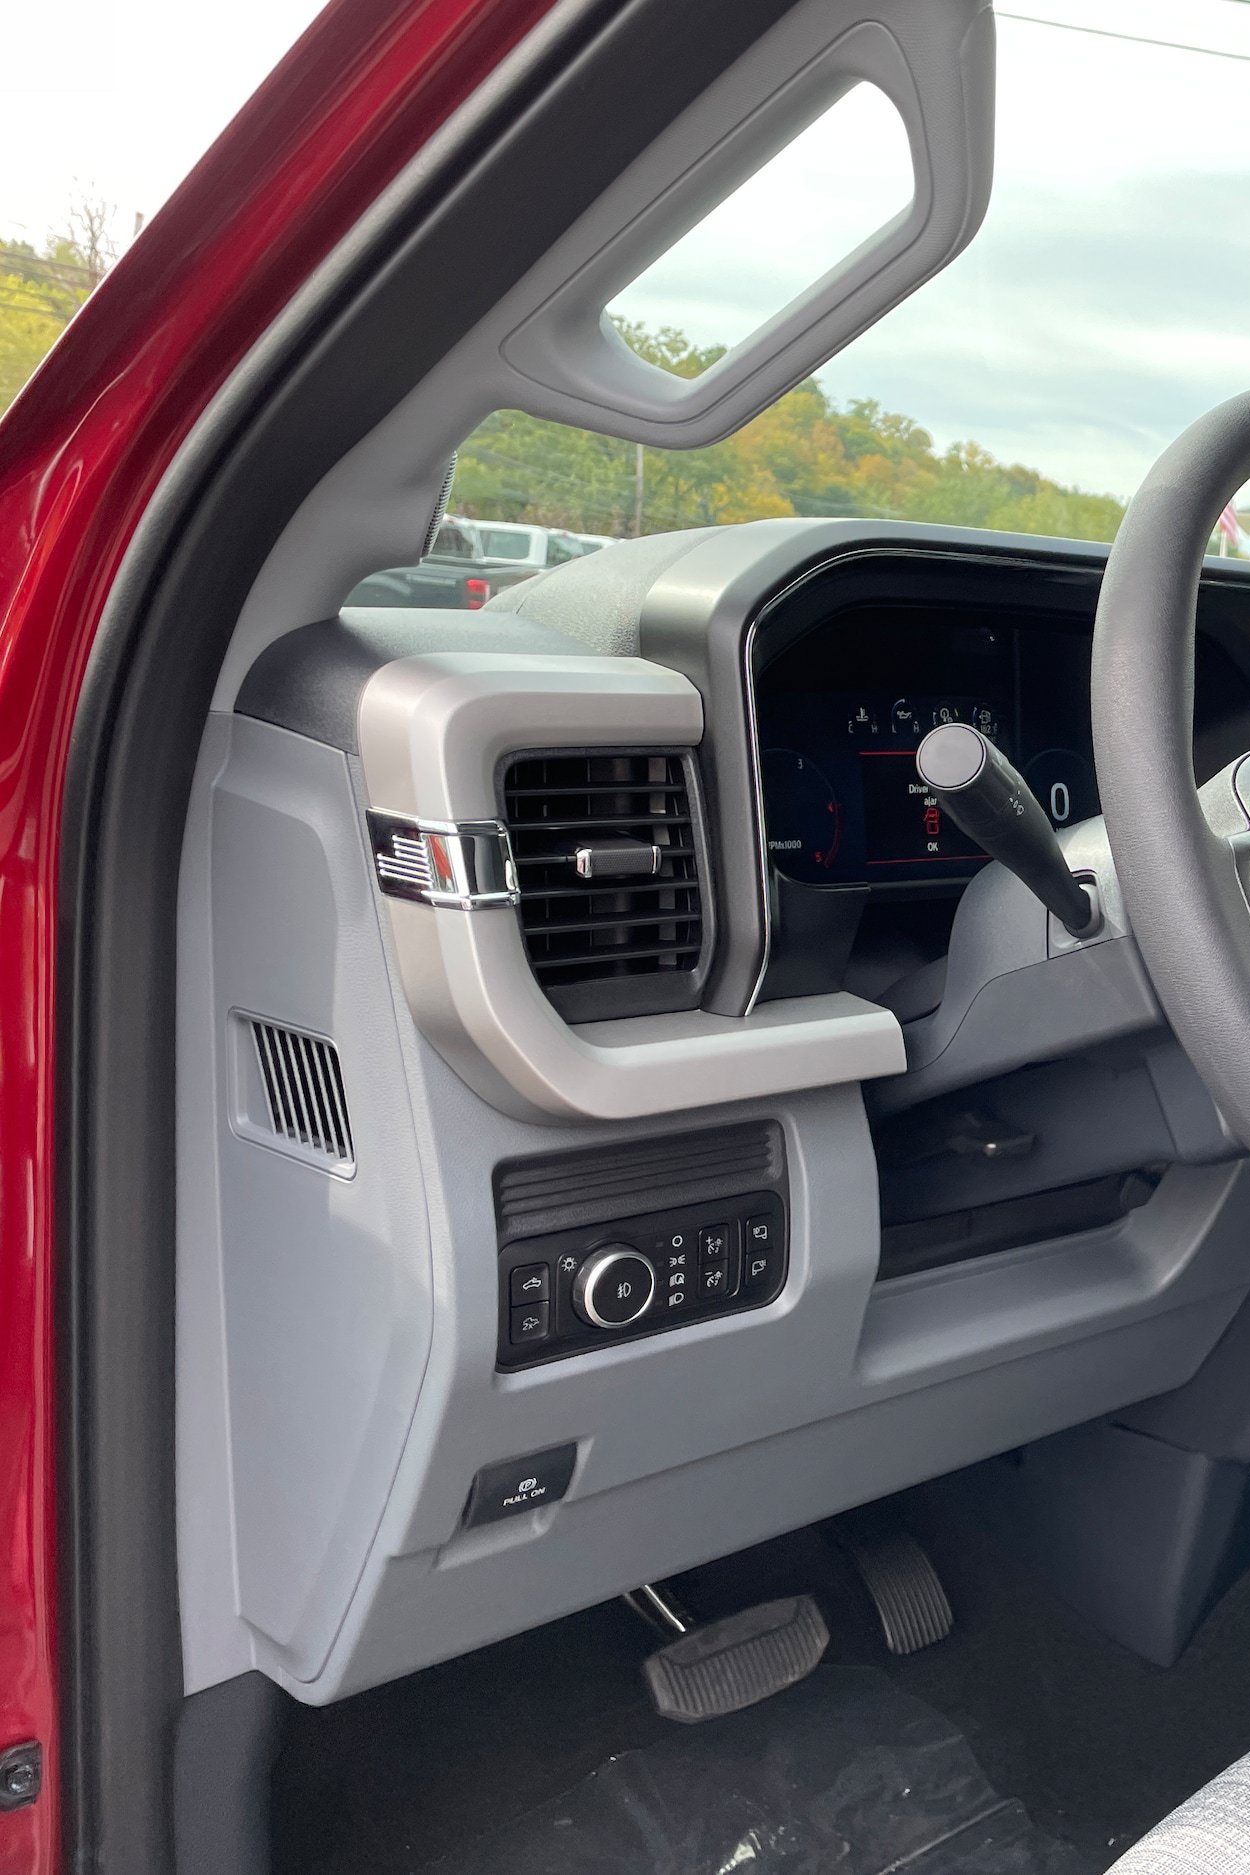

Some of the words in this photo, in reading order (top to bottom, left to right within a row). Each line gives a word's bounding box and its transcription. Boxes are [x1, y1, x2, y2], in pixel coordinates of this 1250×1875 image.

[908, 783, 929, 794] Driver
[924, 796, 937, 807] ajar
[1050, 782, 1070, 822] 0
[927, 842, 938, 852] OK
[503, 1493, 528, 1506] PULL
[530, 1487, 546, 1498] ON
